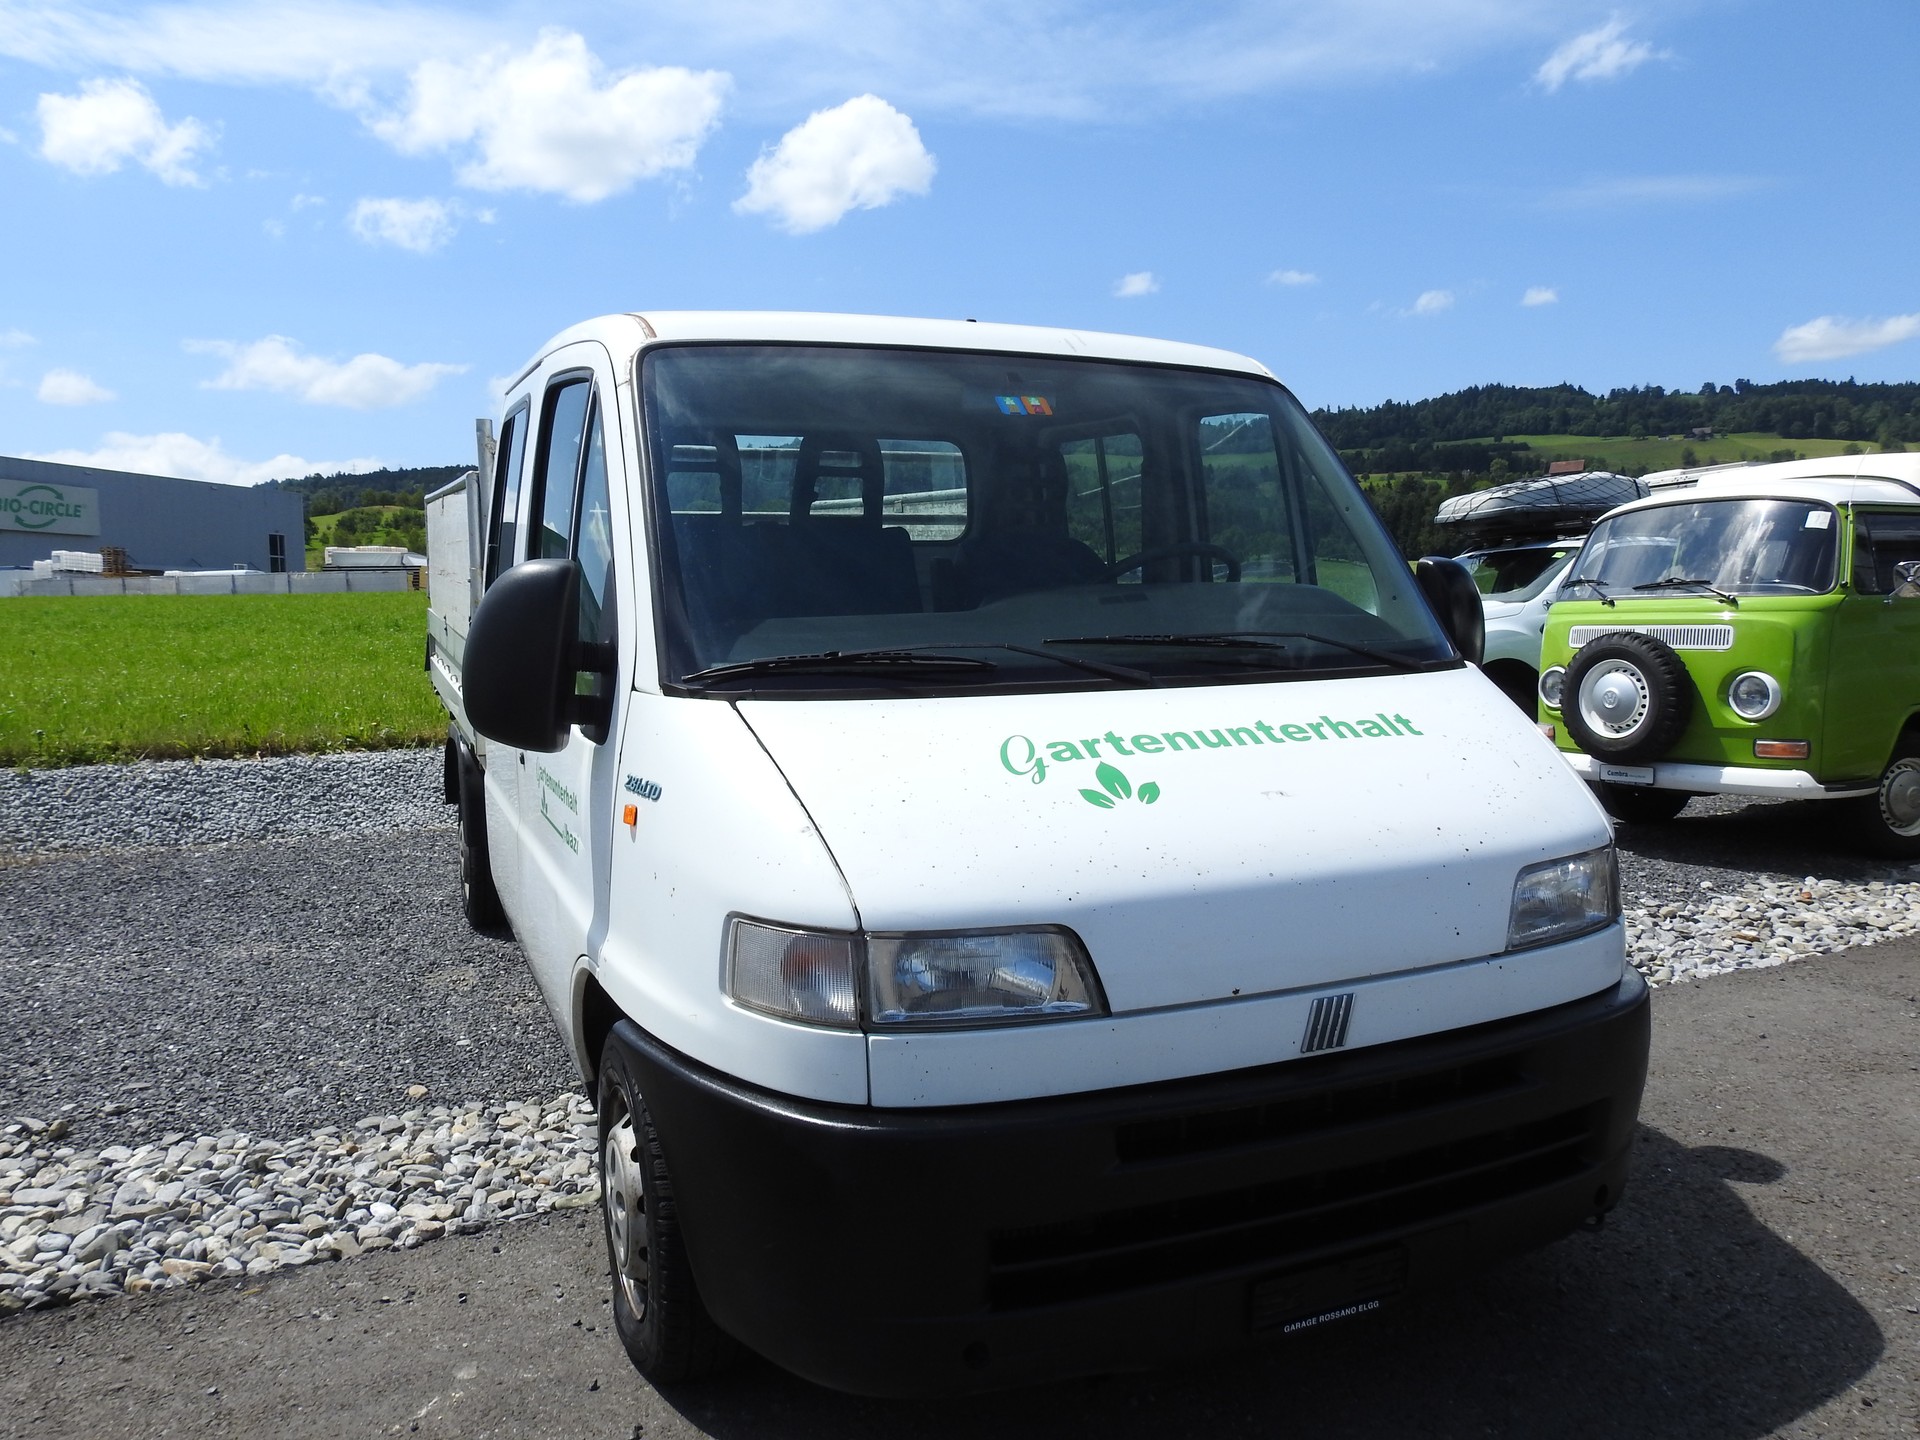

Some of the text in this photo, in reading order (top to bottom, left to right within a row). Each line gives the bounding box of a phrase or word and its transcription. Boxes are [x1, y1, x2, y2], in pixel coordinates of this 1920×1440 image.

[0, 498, 82, 518] IO-CIRCLE
[999, 713, 1425, 785] Gartenunterhalt
[1283, 1317, 1318, 1333] GARAGE
[1319, 1306, 1357, 1323] ROSSANO
